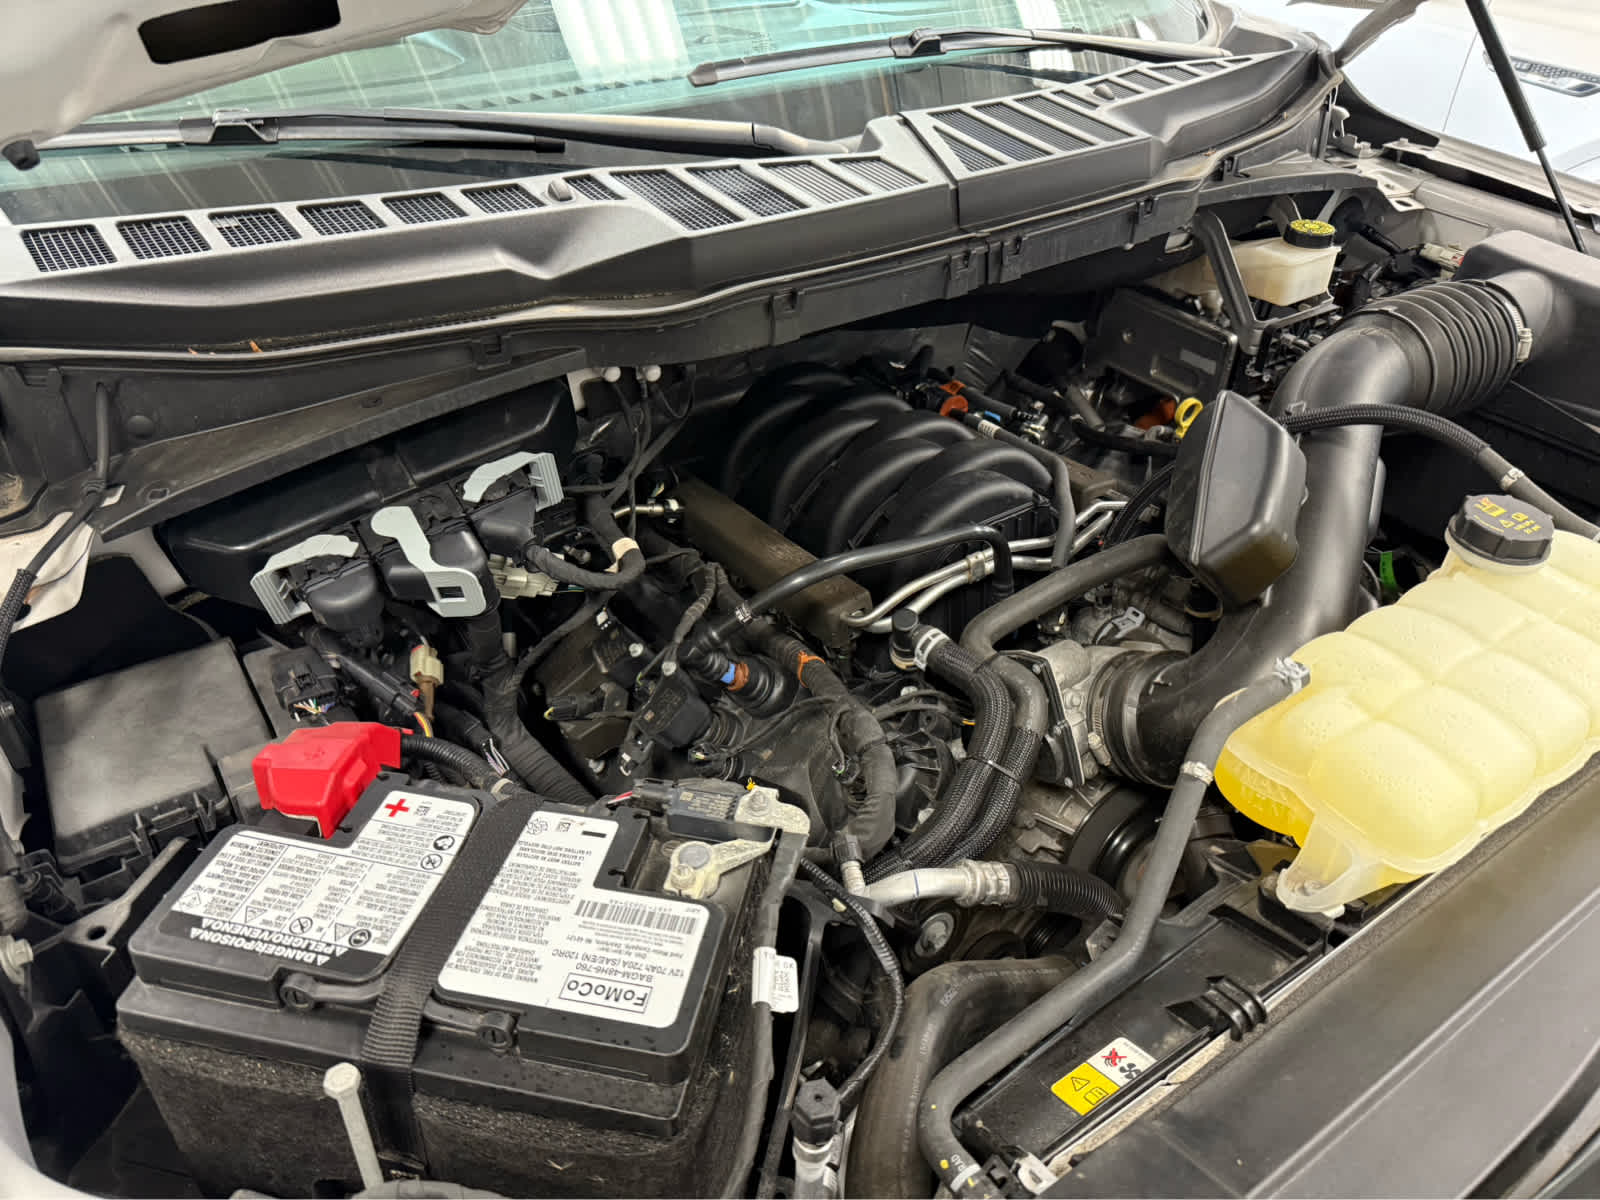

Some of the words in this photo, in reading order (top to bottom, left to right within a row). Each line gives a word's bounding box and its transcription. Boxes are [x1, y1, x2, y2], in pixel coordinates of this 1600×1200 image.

[211, 919, 336, 955] PELIGRO/VENENO
[199, 928, 317, 964] DANGER/POISON
[551, 948, 579, 960] 120RC
[581, 951, 620, 967] (SAE/EN)
[623, 959, 643, 972] 720A
[575, 962, 654, 983] BAGM-48H6-760
[645, 964, 666, 976] 70Ah
[668, 968, 685, 977] 12V
[567, 979, 648, 1007] FoMoCo
